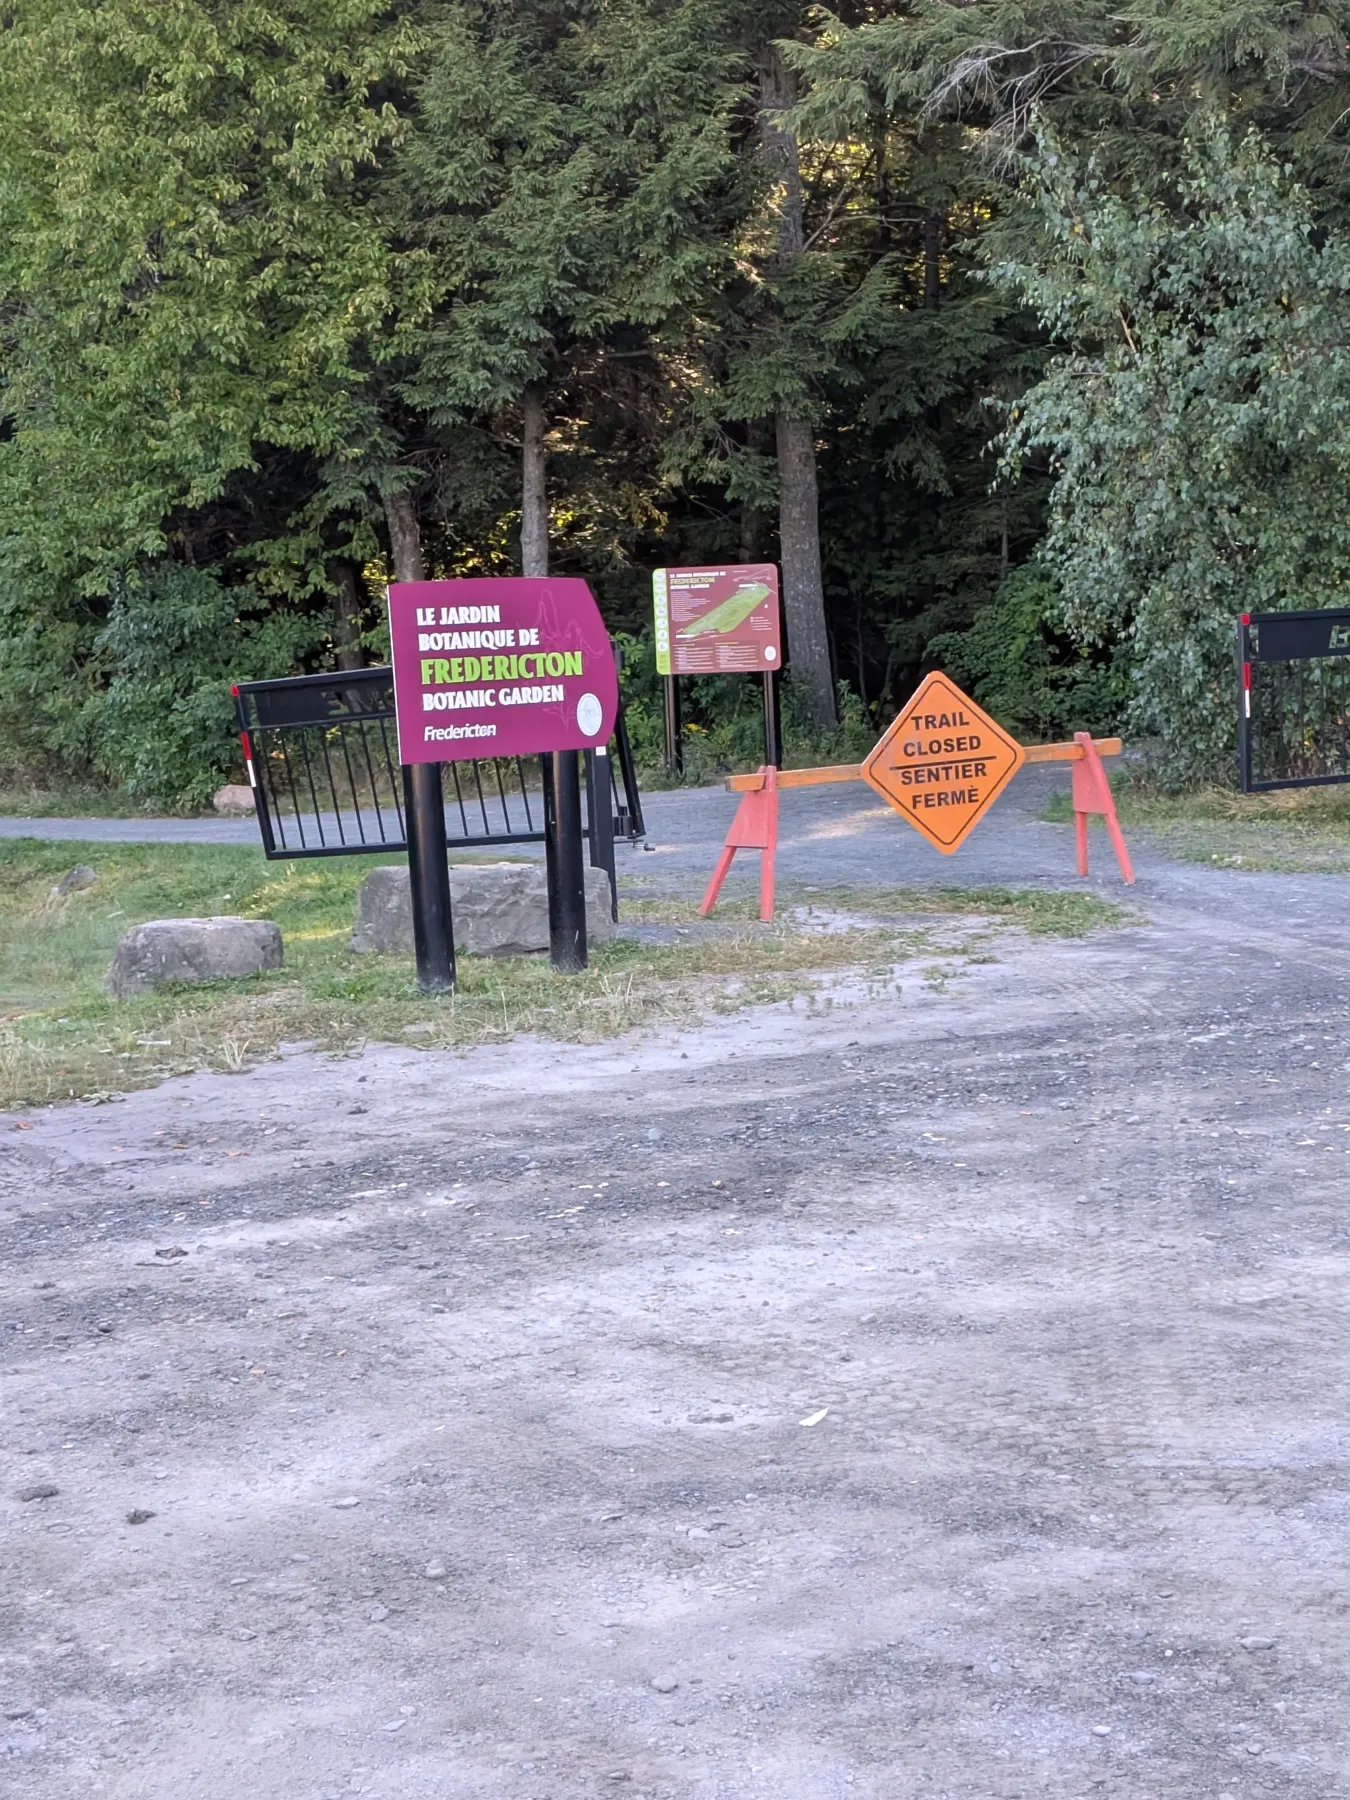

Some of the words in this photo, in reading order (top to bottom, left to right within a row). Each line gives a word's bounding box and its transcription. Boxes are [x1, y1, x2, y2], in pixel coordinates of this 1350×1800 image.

[416, 607, 436, 626] LE
[439, 605, 501, 625] JARDIN
[418, 630, 515, 651] BOTANIQUE
[518, 628, 540, 646] DE
[420, 651, 583, 685] FREDERICTON
[422, 689, 496, 711] BOTANIC
[498, 684, 565, 706] GARDEN
[424, 723, 497, 742] Fredericton
[911, 712, 970, 731] TRAIL
[903, 735, 981, 757] CLOSED
[901, 763, 987, 786] SENTIER
